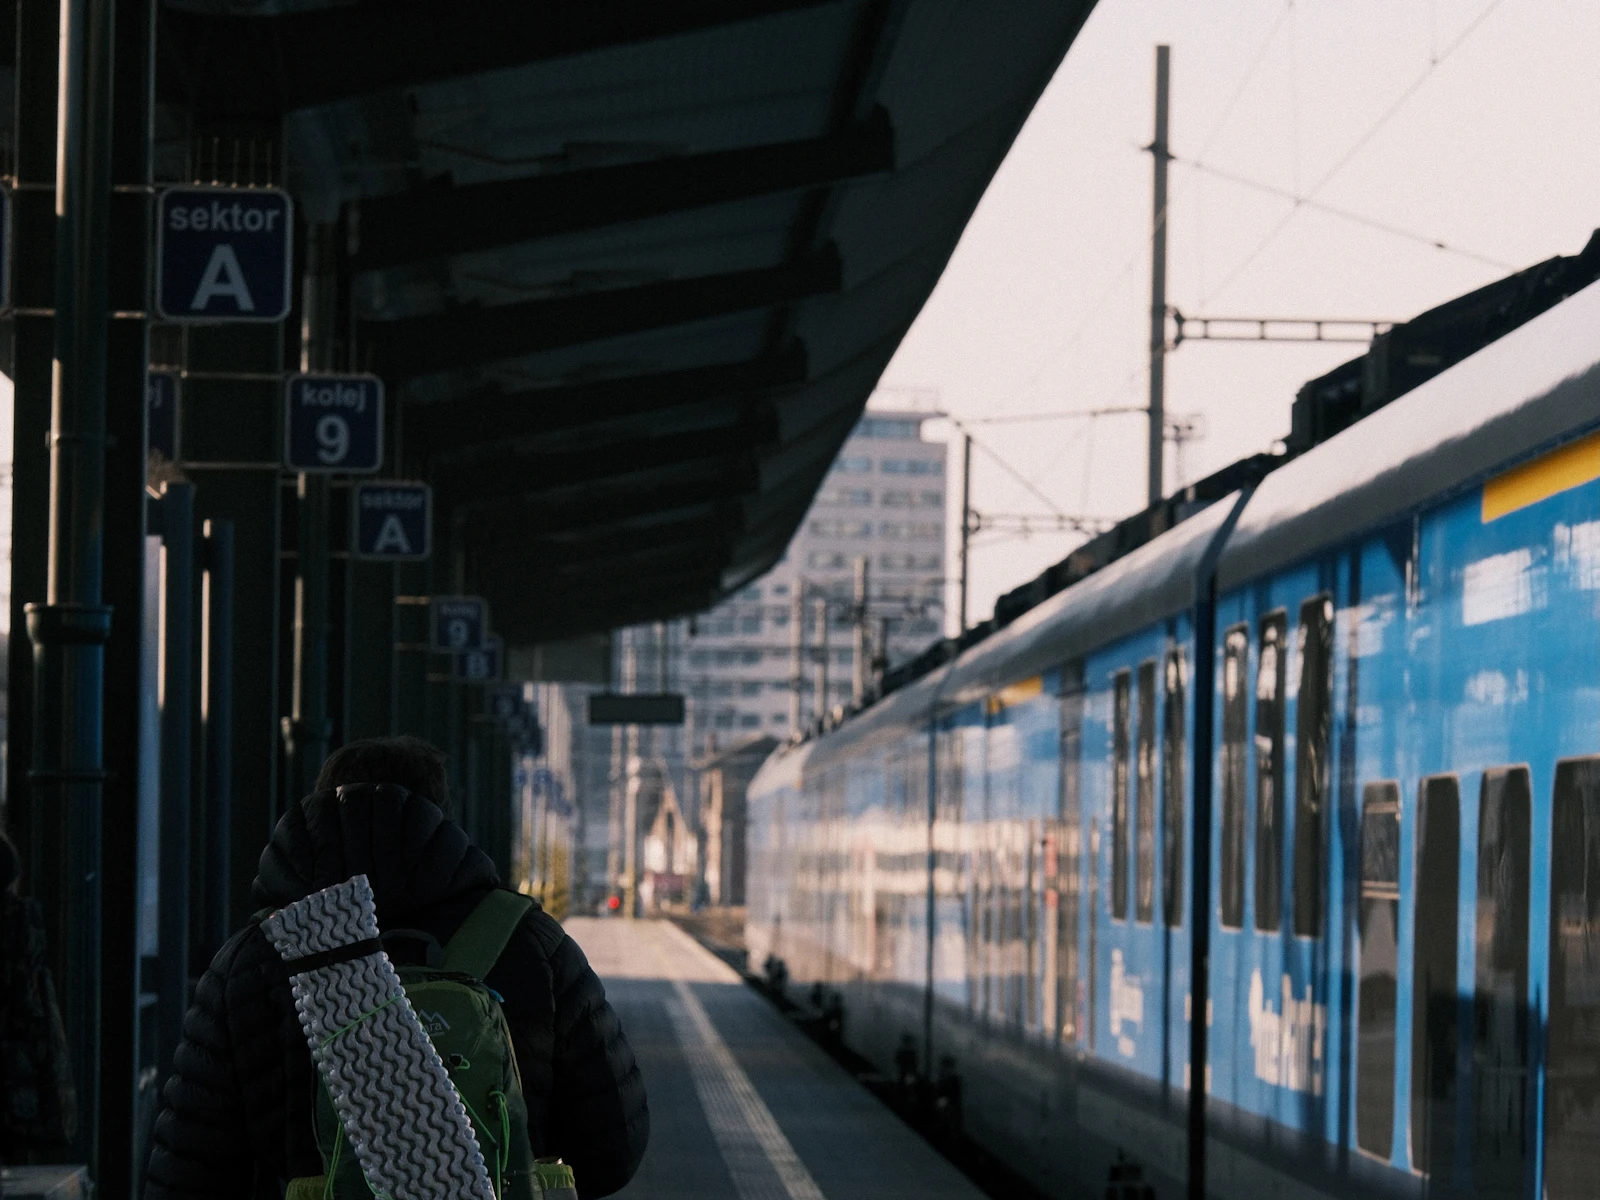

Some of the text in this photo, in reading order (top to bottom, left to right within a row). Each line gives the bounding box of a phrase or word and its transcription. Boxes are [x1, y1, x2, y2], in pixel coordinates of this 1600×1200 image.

[169, 199, 281, 231] sektor
[189, 243, 257, 311] A
[300, 381, 366, 413] kolej
[315, 414, 349, 464] 9
[374, 515, 412, 553] A
[447, 618, 468, 647] 9
